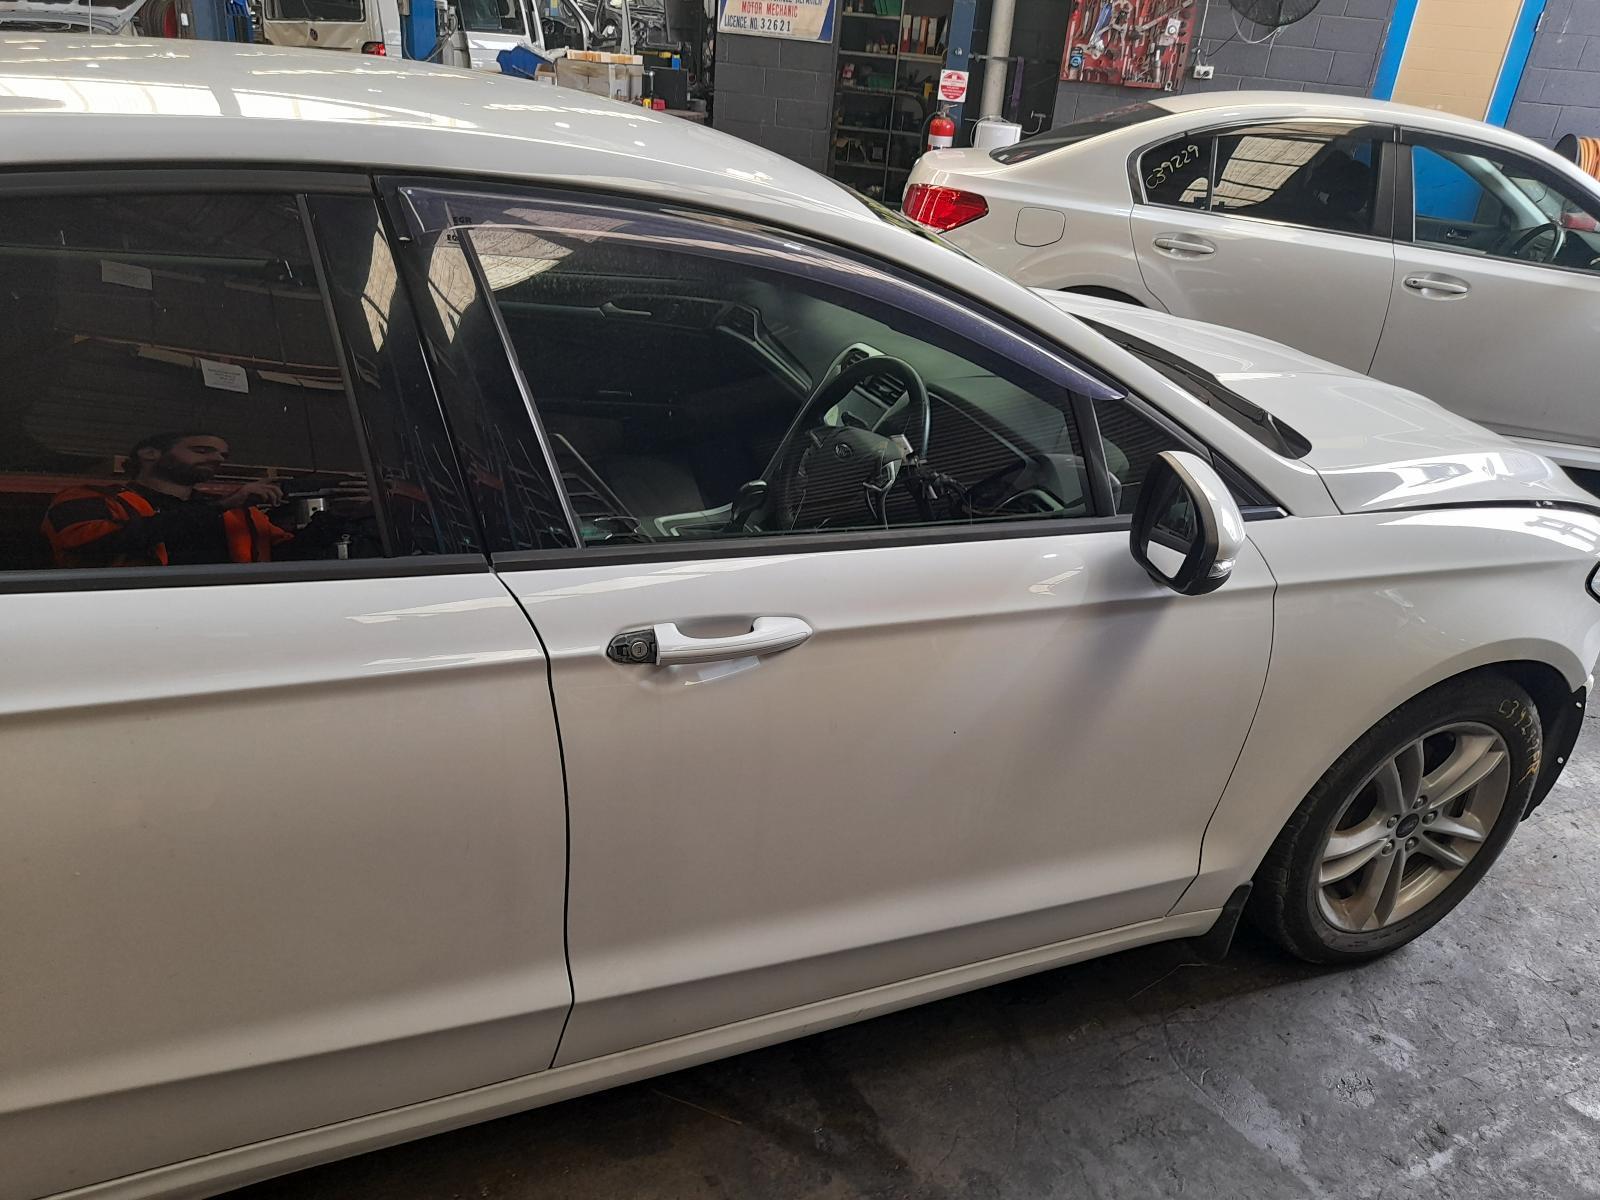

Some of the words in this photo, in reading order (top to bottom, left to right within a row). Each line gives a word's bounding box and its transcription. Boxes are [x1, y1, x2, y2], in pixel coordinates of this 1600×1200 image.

[742, 2, 763, 14] MOTOR
[767, 3, 798, 18] MECHANIC
[724, 14, 747, 28] LICENCE
[761, 18, 790, 31] 32621
[1146, 145, 1199, 189] C39229
